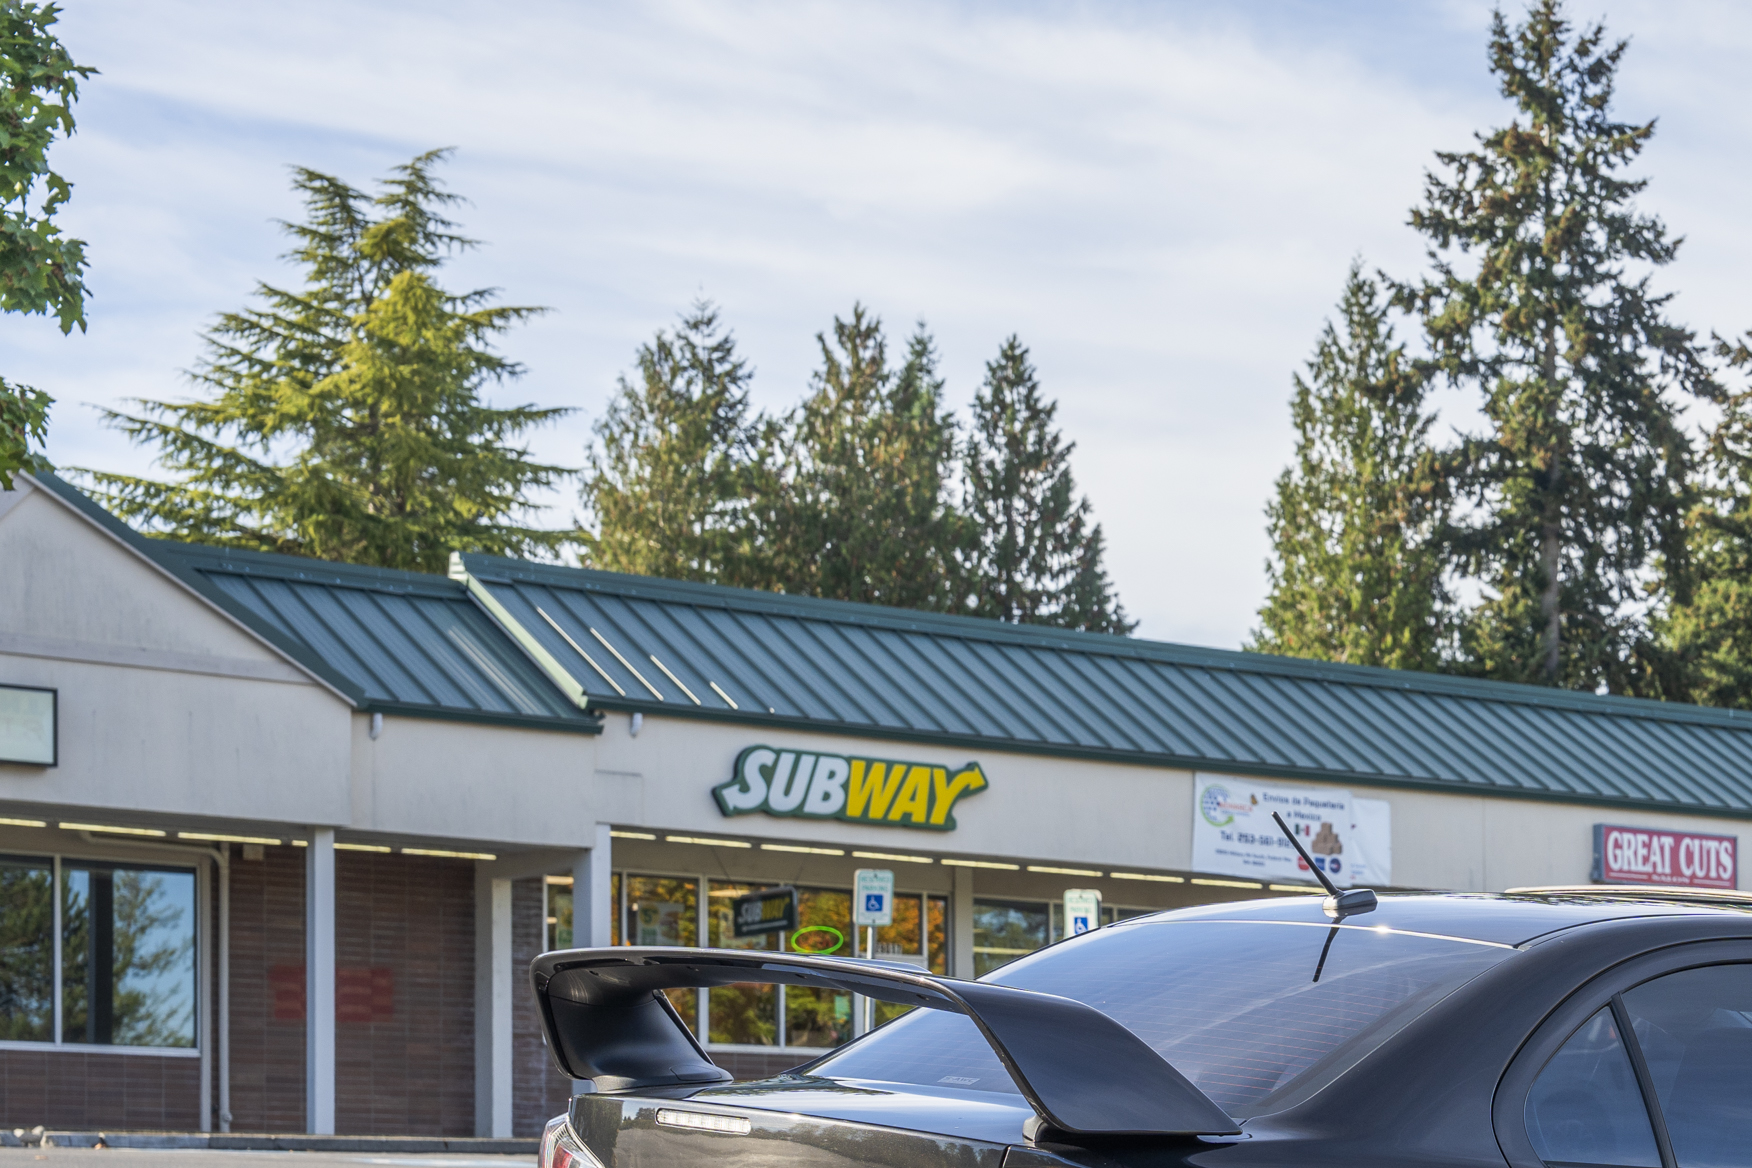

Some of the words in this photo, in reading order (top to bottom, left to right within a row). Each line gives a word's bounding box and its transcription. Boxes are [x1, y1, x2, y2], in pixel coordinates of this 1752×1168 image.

[722, 749, 986, 825] SUBWAY
[1607, 831, 1674, 874] GREAT
[1679, 837, 1733, 880] CUTS
[737, 896, 791, 924] SUBWAY
